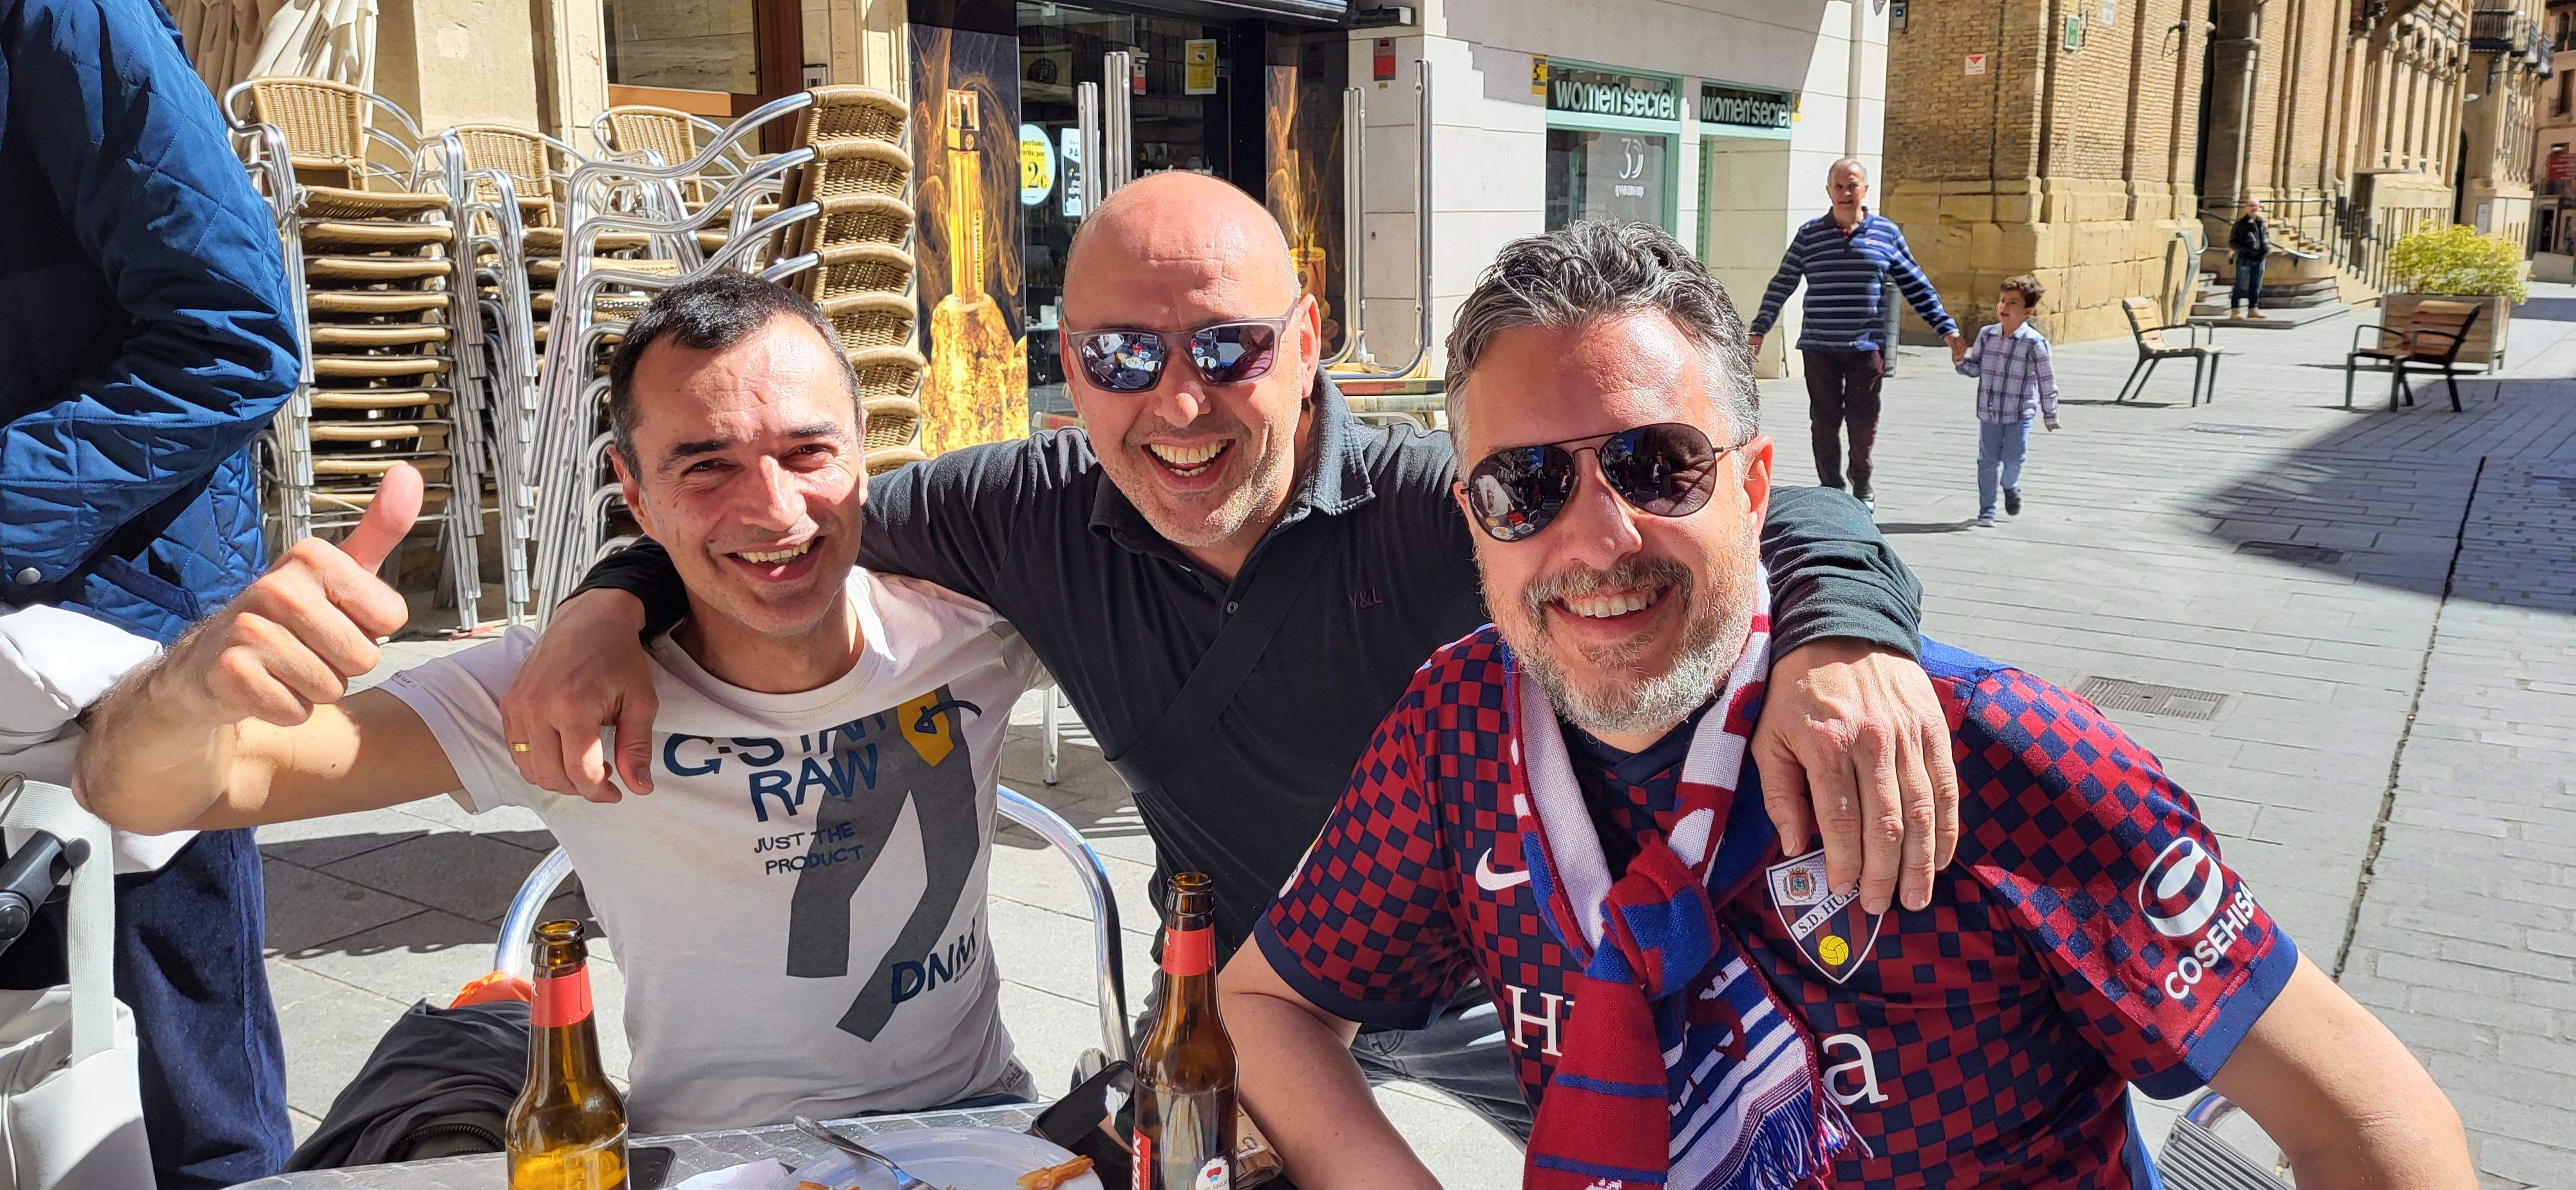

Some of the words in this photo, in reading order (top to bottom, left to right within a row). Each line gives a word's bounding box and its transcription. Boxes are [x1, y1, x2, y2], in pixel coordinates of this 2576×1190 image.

[1555, 80, 1676, 119] women'secret
[1701, 95, 1792, 127] women'secret
[749, 742, 878, 822] RAW
[753, 832, 805, 854] JUST
[811, 821, 855, 844] THE
[765, 844, 864, 876] PRODUCT
[2165, 881, 2255, 999] COSEHISA
[891, 916, 976, 1005] DNM
